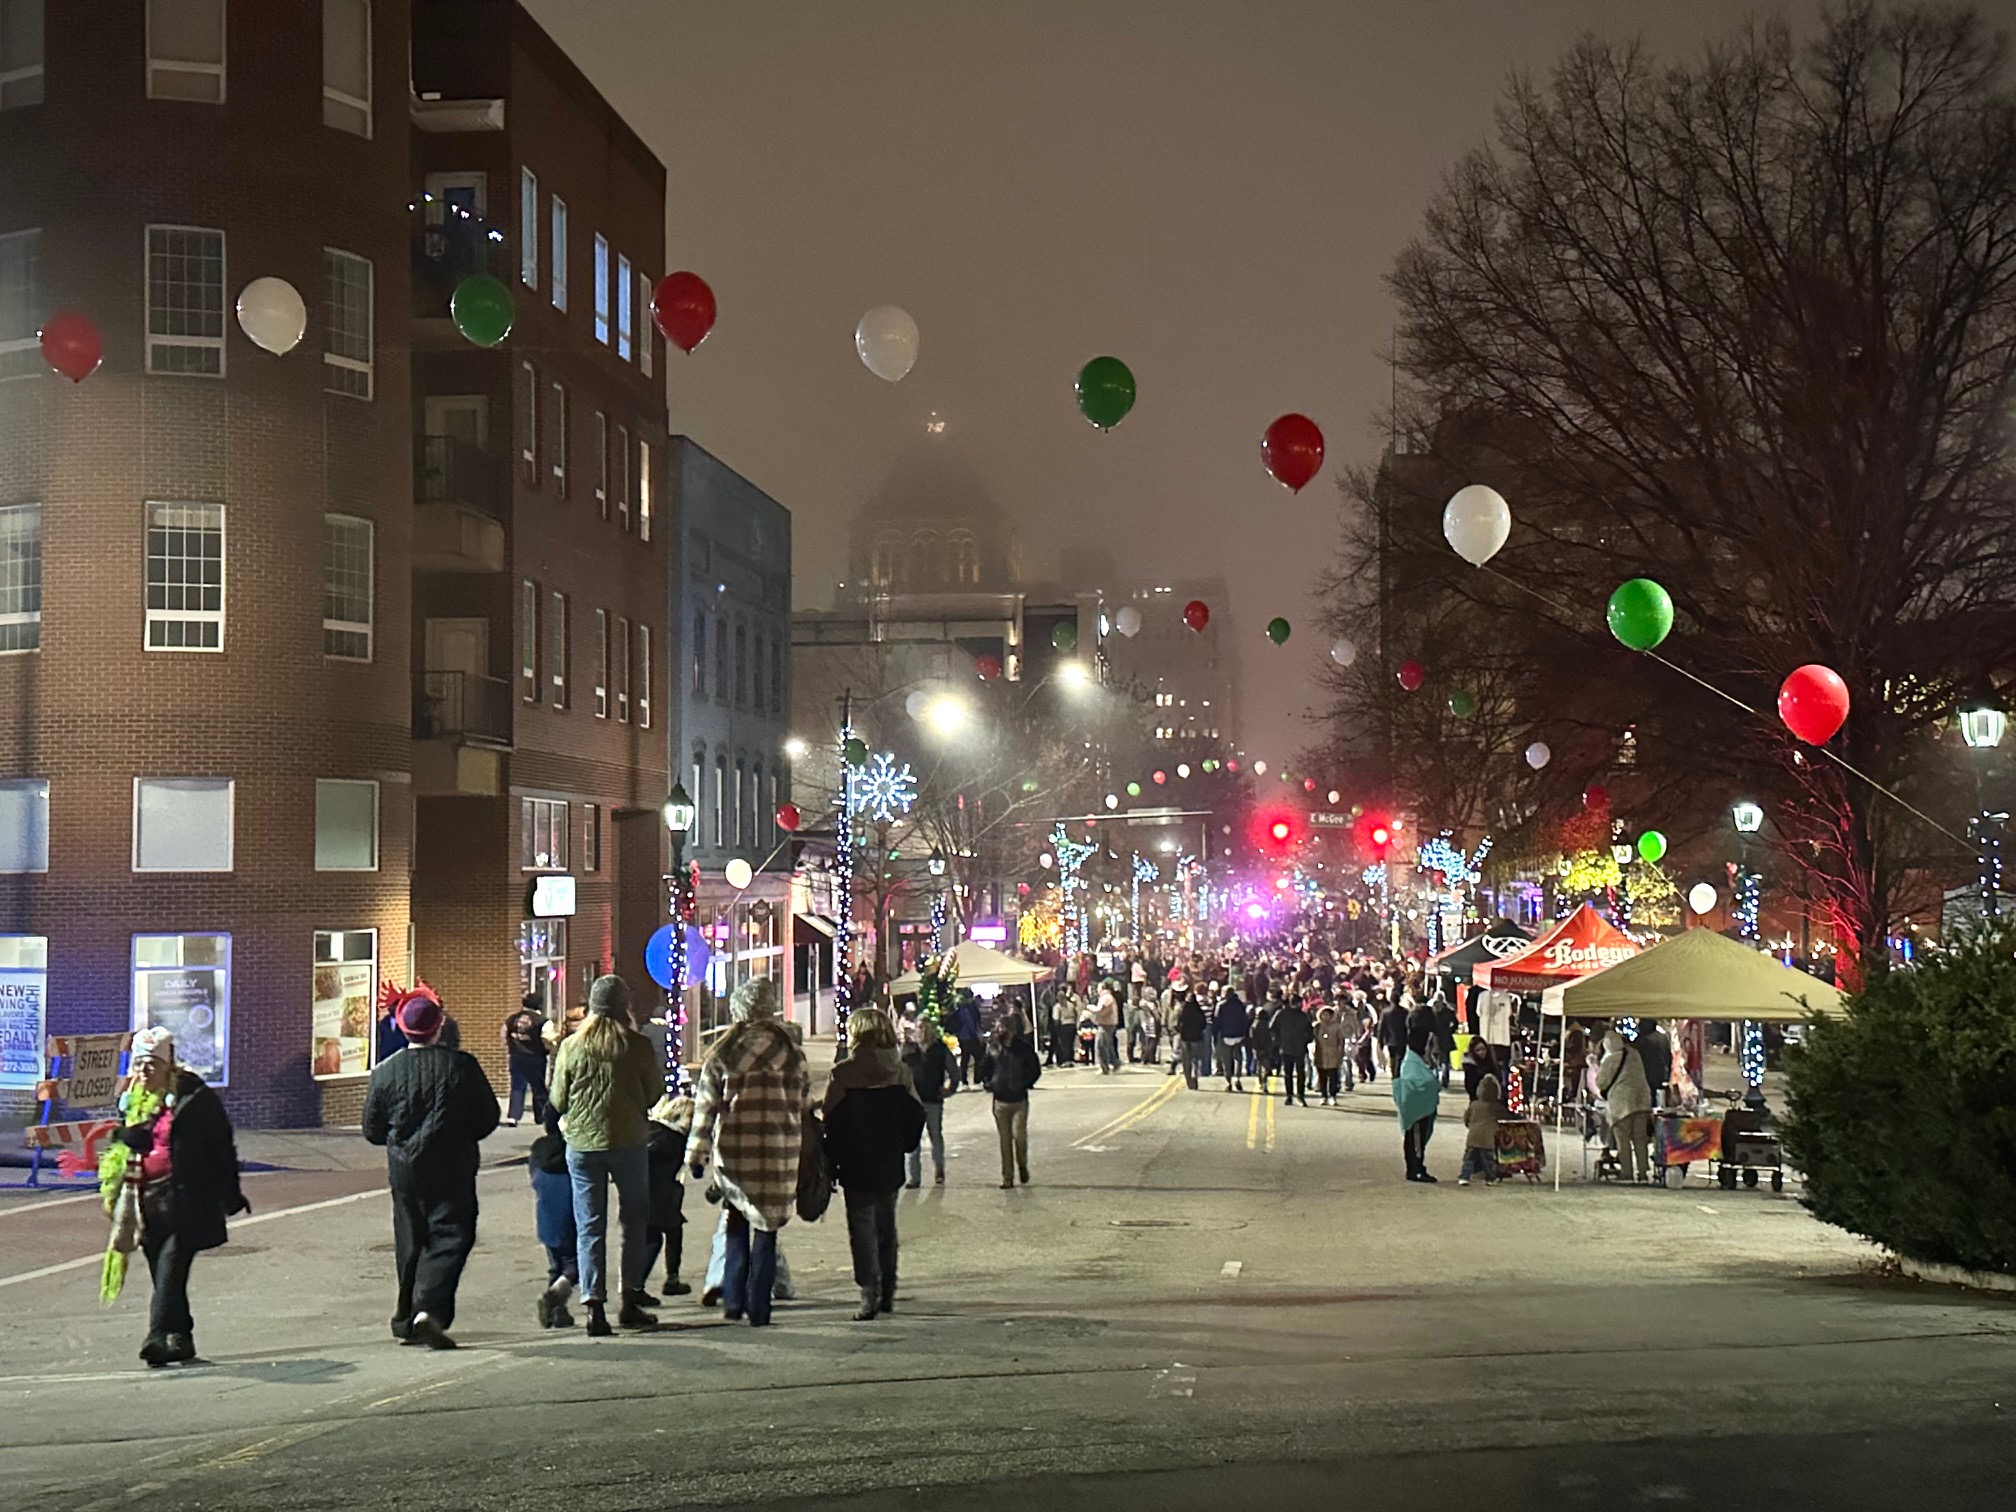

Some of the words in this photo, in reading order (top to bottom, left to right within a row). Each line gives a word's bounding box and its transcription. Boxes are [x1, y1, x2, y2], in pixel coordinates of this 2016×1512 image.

[1319, 812, 1344, 824] McGee
[1543, 938, 1636, 968] Bodega
[79, 1048, 115, 1070] STREET
[74, 1077, 111, 1099] CLOSED
